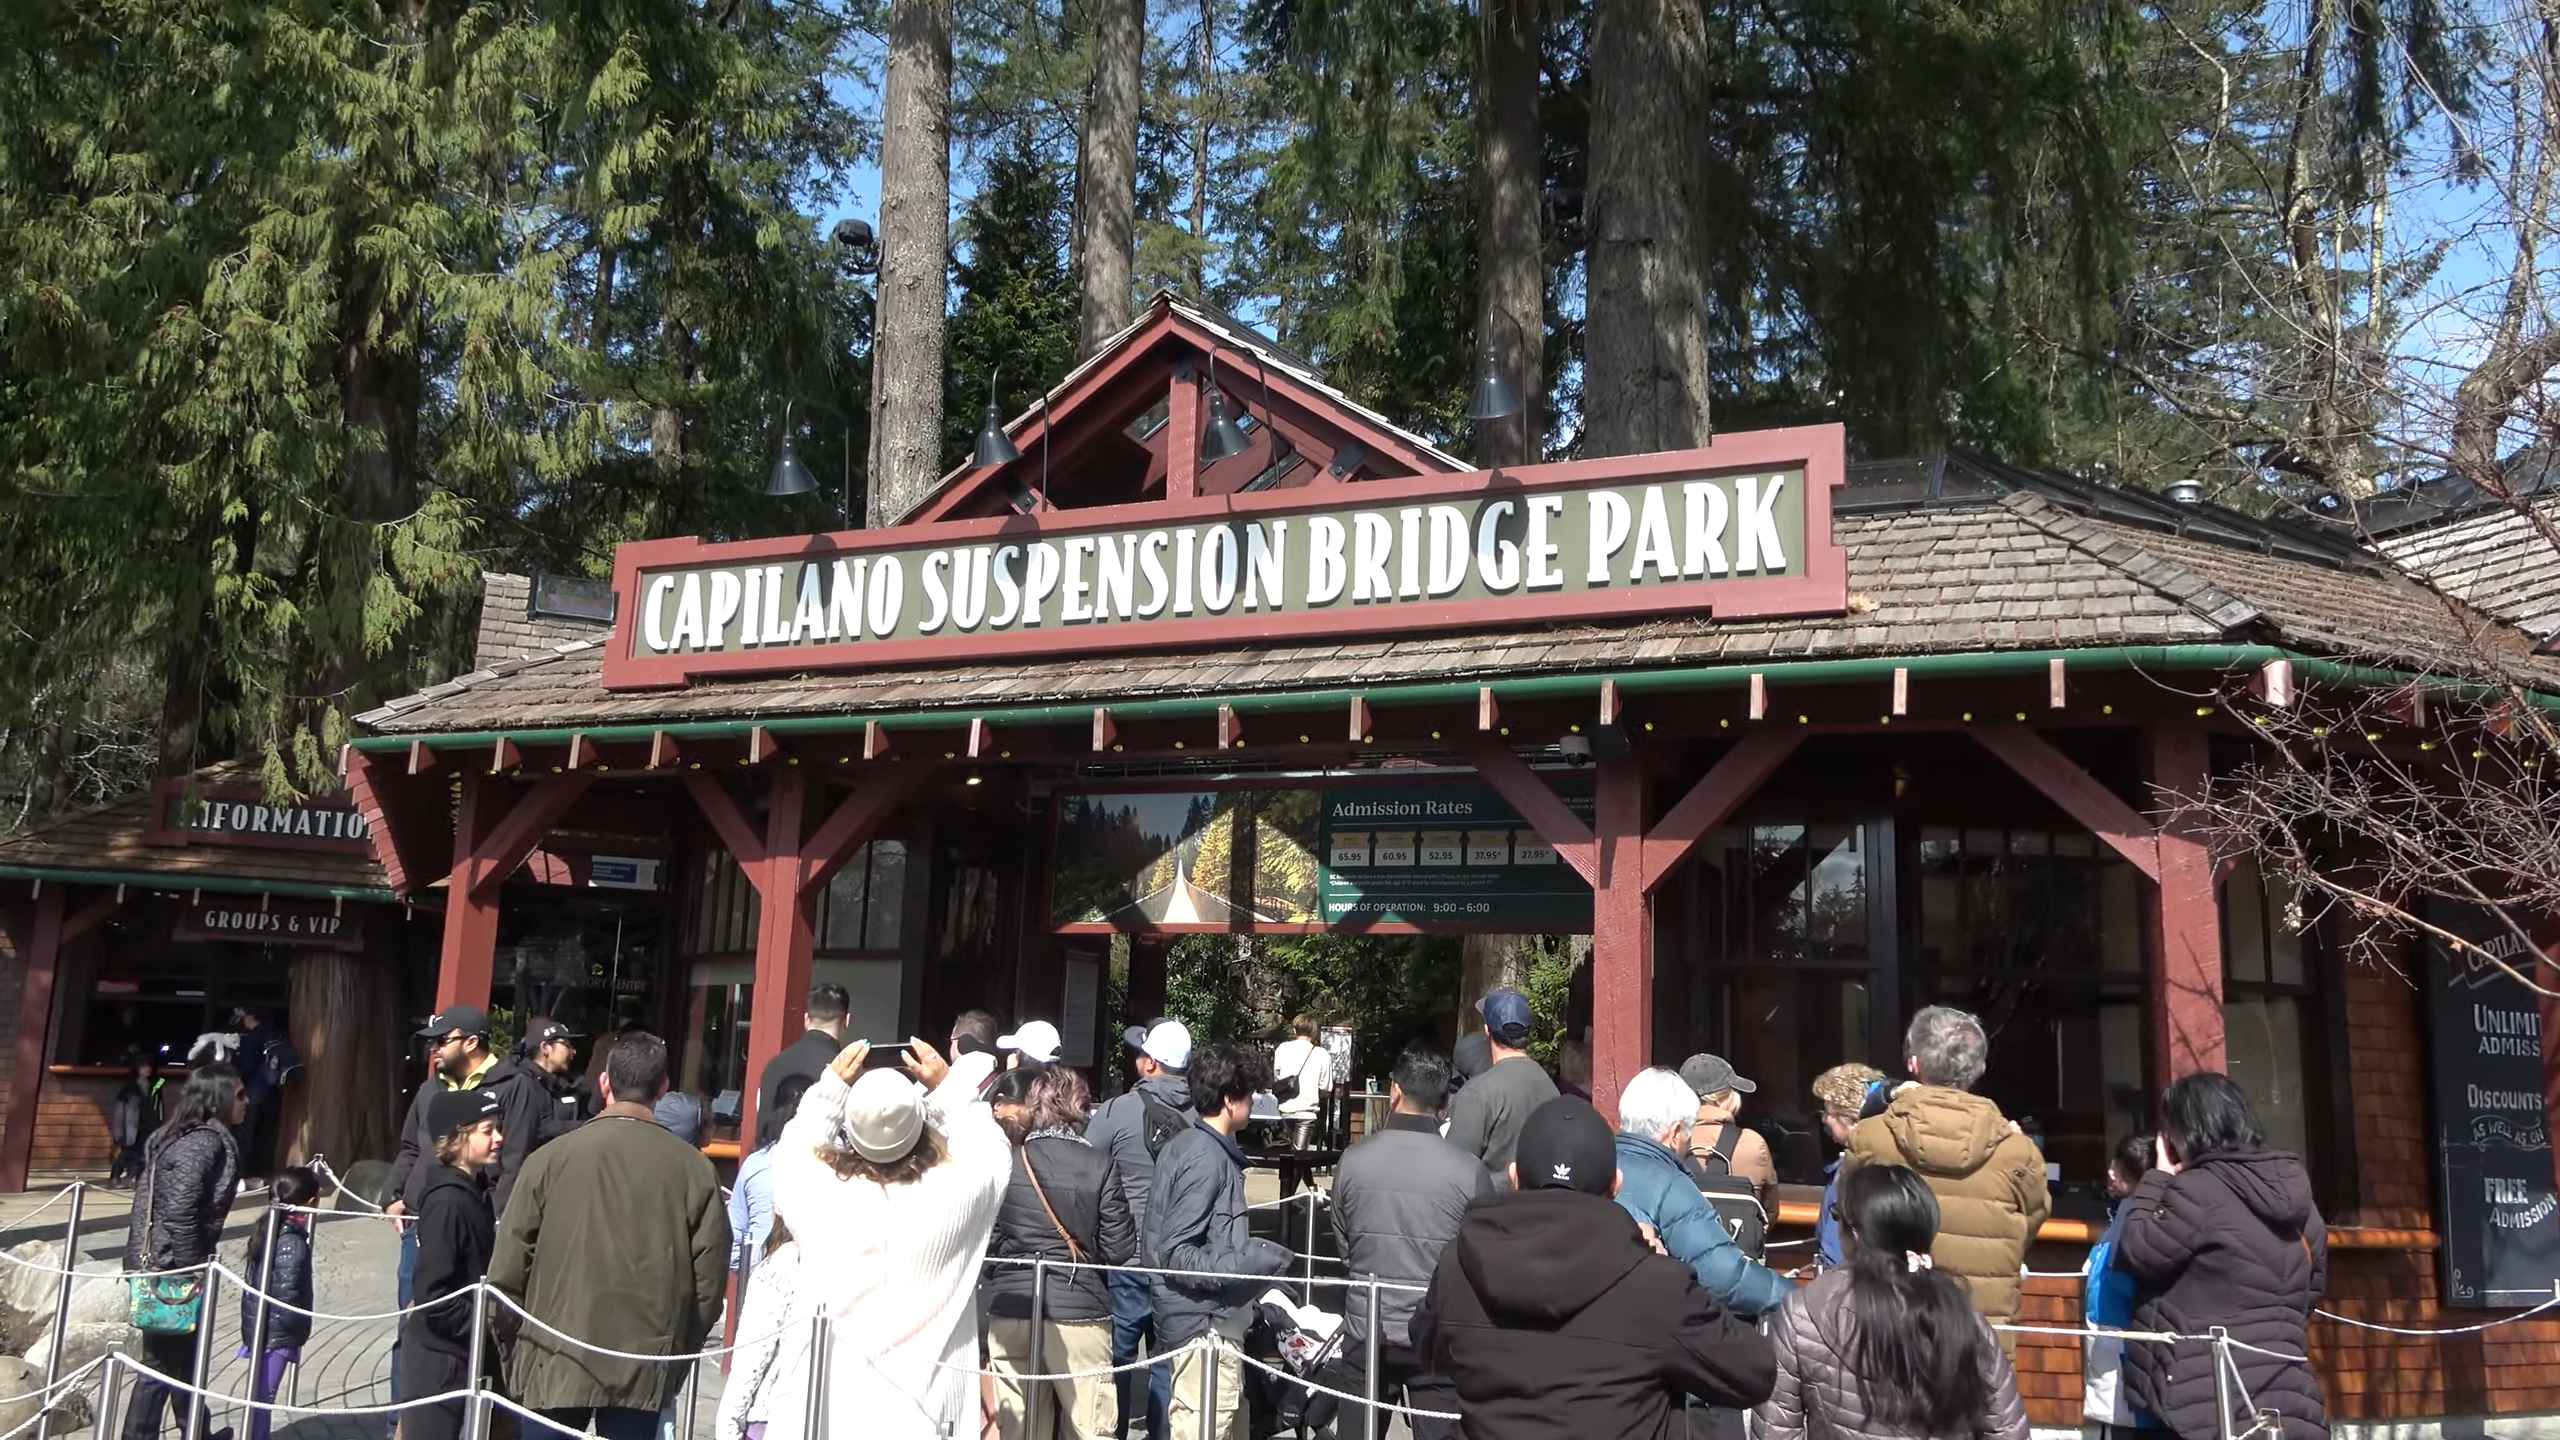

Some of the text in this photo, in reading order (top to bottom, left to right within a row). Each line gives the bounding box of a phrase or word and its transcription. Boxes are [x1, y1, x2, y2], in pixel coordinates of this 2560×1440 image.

[644, 474, 1788, 652] CAPILANO SUSPENSION BRIDGE PARK
[1332, 800, 1473, 817] Admission Rates
[1338, 852, 1362, 861] 65.95
[1382, 852, 1408, 861] 60.95
[1328, 903, 1359, 912] HOURS
[1360, 903, 1373, 912] OF
[1373, 902, 1427, 912] OPERATION:
[1433, 902, 1457, 913] 9:00
[1466, 902, 1490, 912] 6:00
[204, 910, 341, 934] GROUPS & VIP
[2478, 1036, 2542, 1057] ADMISS
[2467, 1084, 2543, 1111] DISCOUNTS
[2472, 1123, 2487, 1141] AS
[2488, 1120, 2513, 1138] WELL
[2513, 1131, 2528, 1146] AS
[2484, 1177, 2529, 1205] FREE
[2489, 1193, 2558, 1230] ADMISSION
